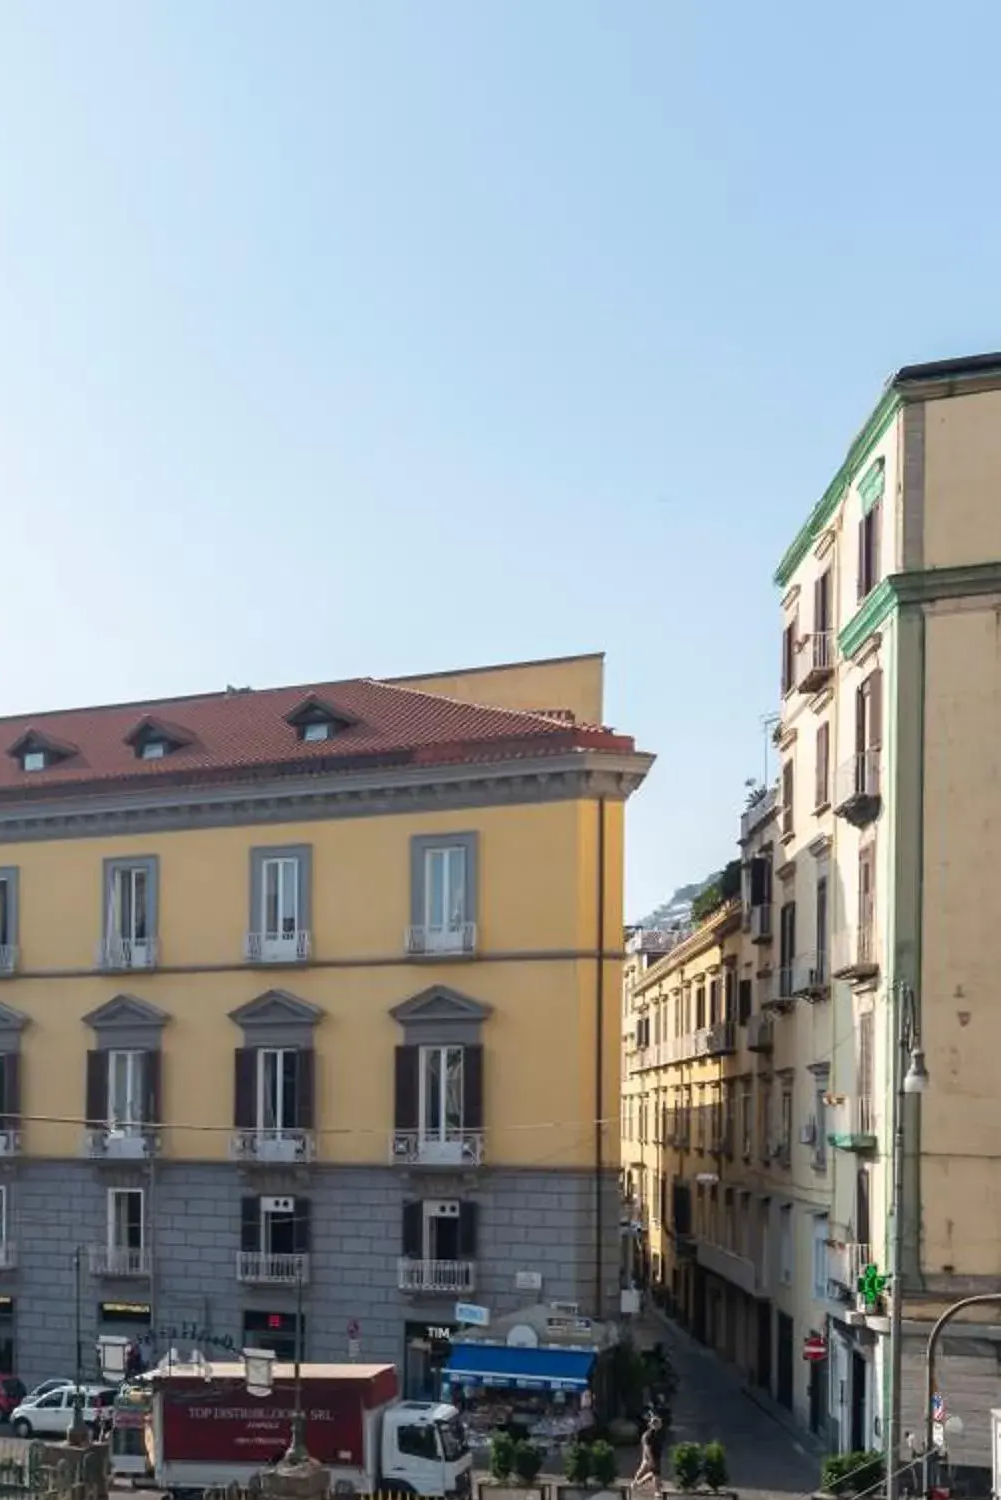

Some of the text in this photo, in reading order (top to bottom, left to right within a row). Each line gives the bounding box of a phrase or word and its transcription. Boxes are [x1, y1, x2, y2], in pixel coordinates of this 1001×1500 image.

[427, 1326, 450, 1339] TIM
[189, 1407, 212, 1419] TOP
[213, 1407, 306, 1420] DISTRIBUZIO
